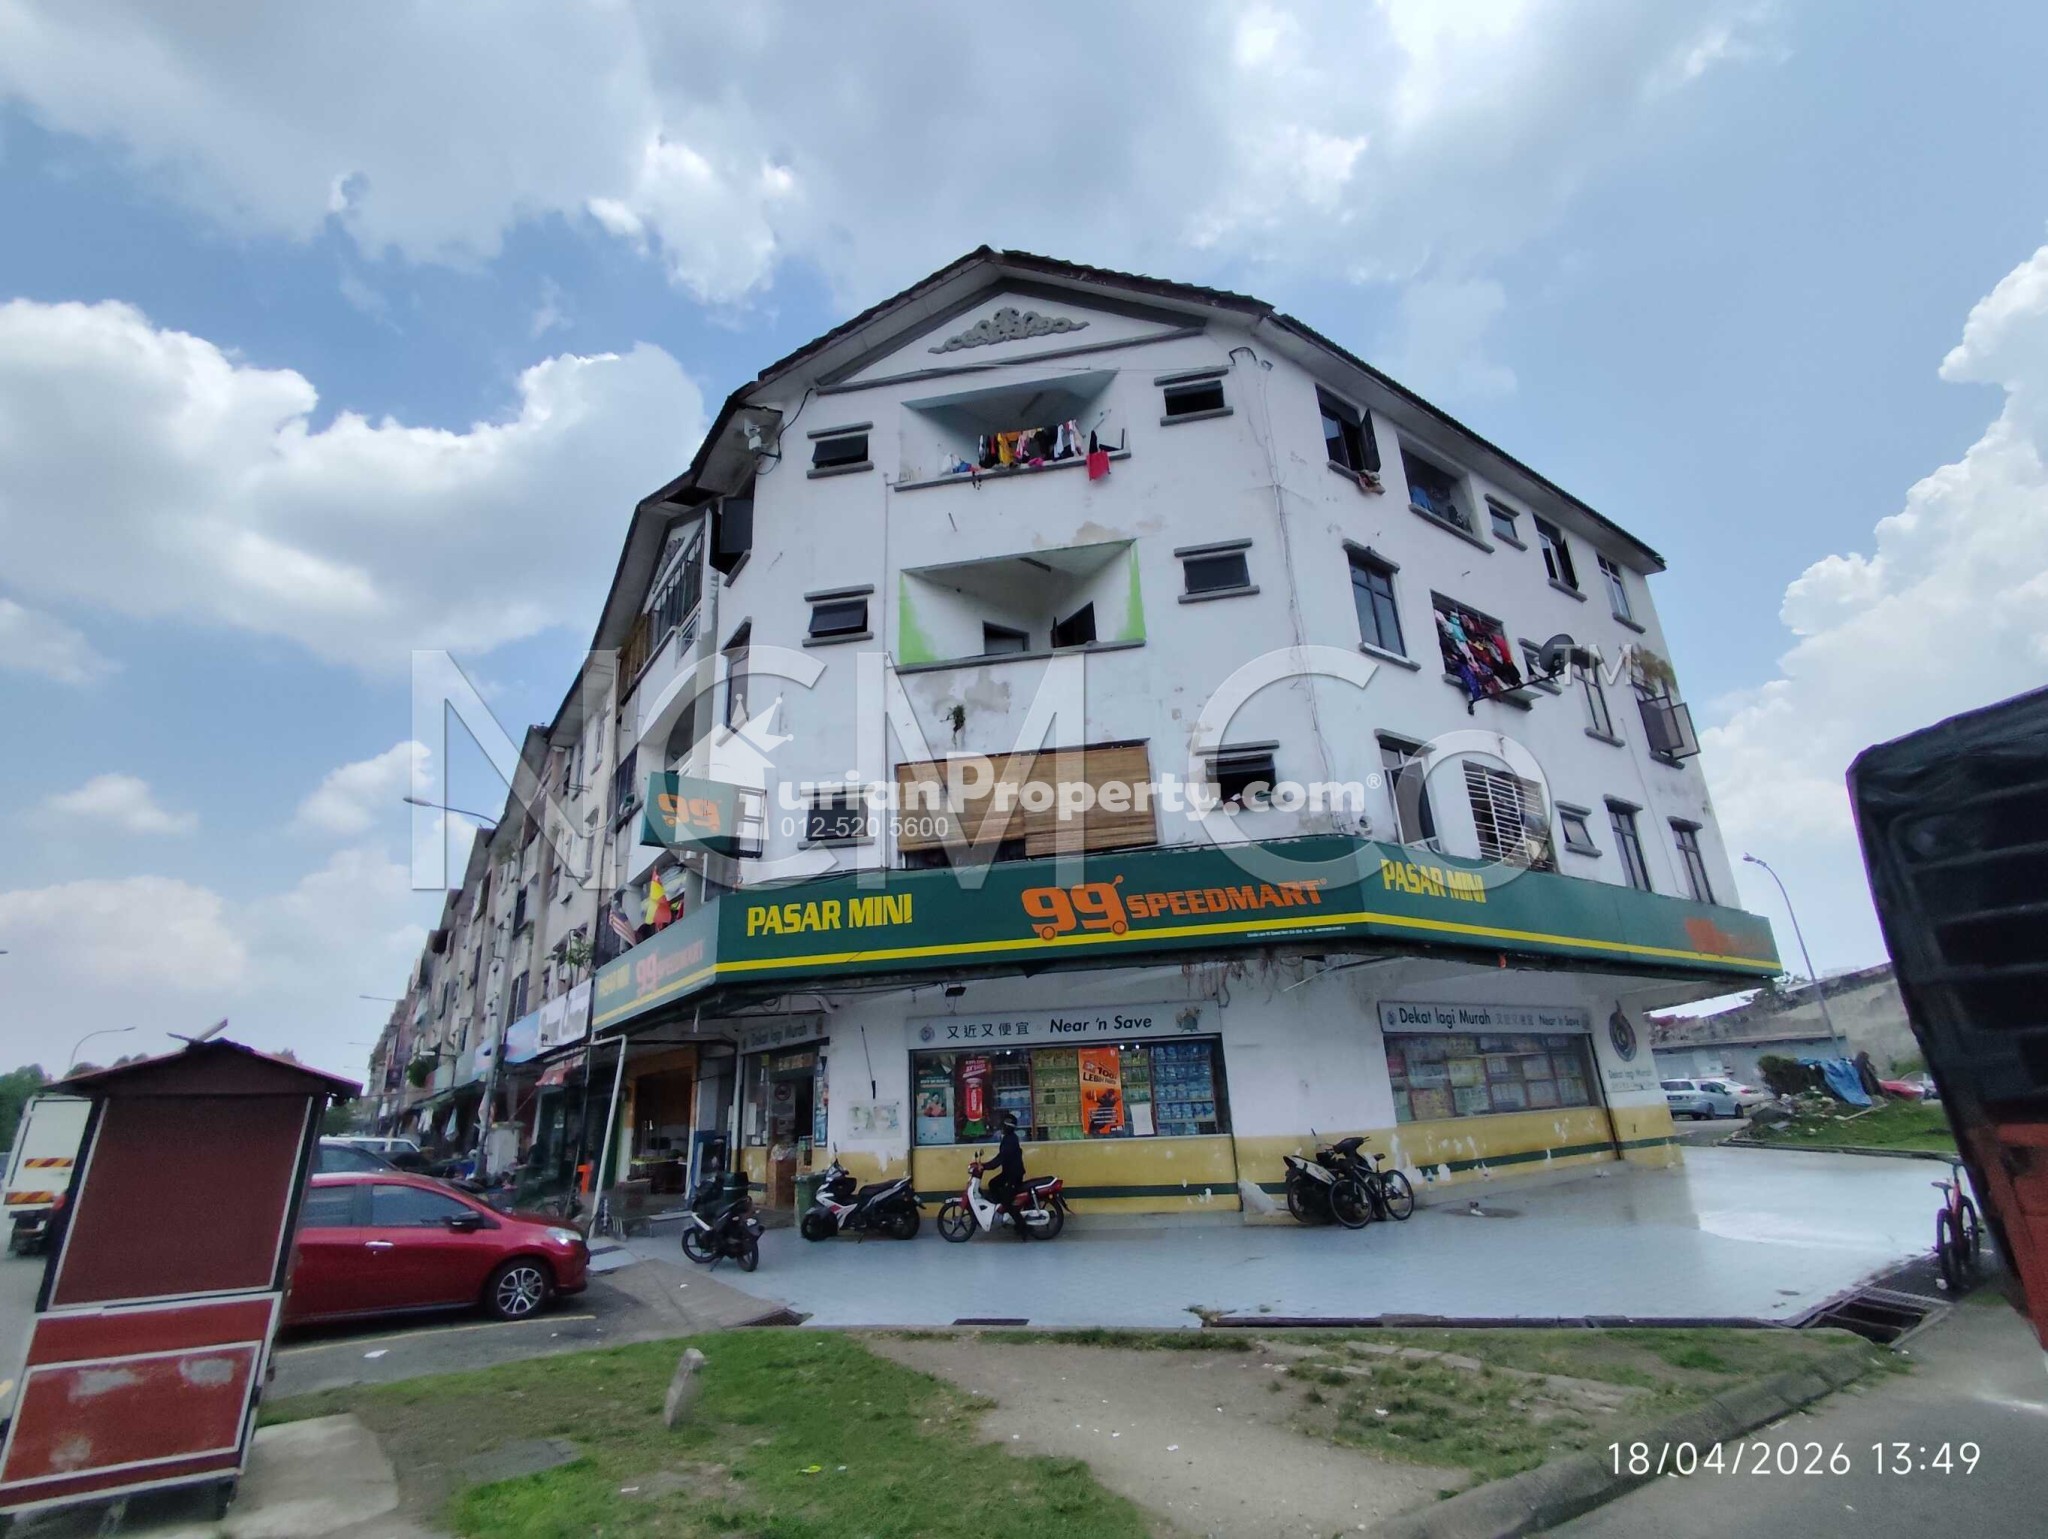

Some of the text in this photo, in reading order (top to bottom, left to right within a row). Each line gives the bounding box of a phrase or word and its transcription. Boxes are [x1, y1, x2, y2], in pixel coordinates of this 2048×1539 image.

[657, 793, 721, 834] 99
[1380, 858, 1487, 903] PASAR MINI
[746, 893, 913, 937] PASAR MINI
[1021, 875, 1322, 942] 99 SPEEDMART
[946, 1021, 1030, 1039] 又近又便宜
[1050, 1018, 1090, 1034] Near
[1113, 1014, 1152, 1030] Save
[1399, 1006, 1491, 1029] Dekat lagi Murah
